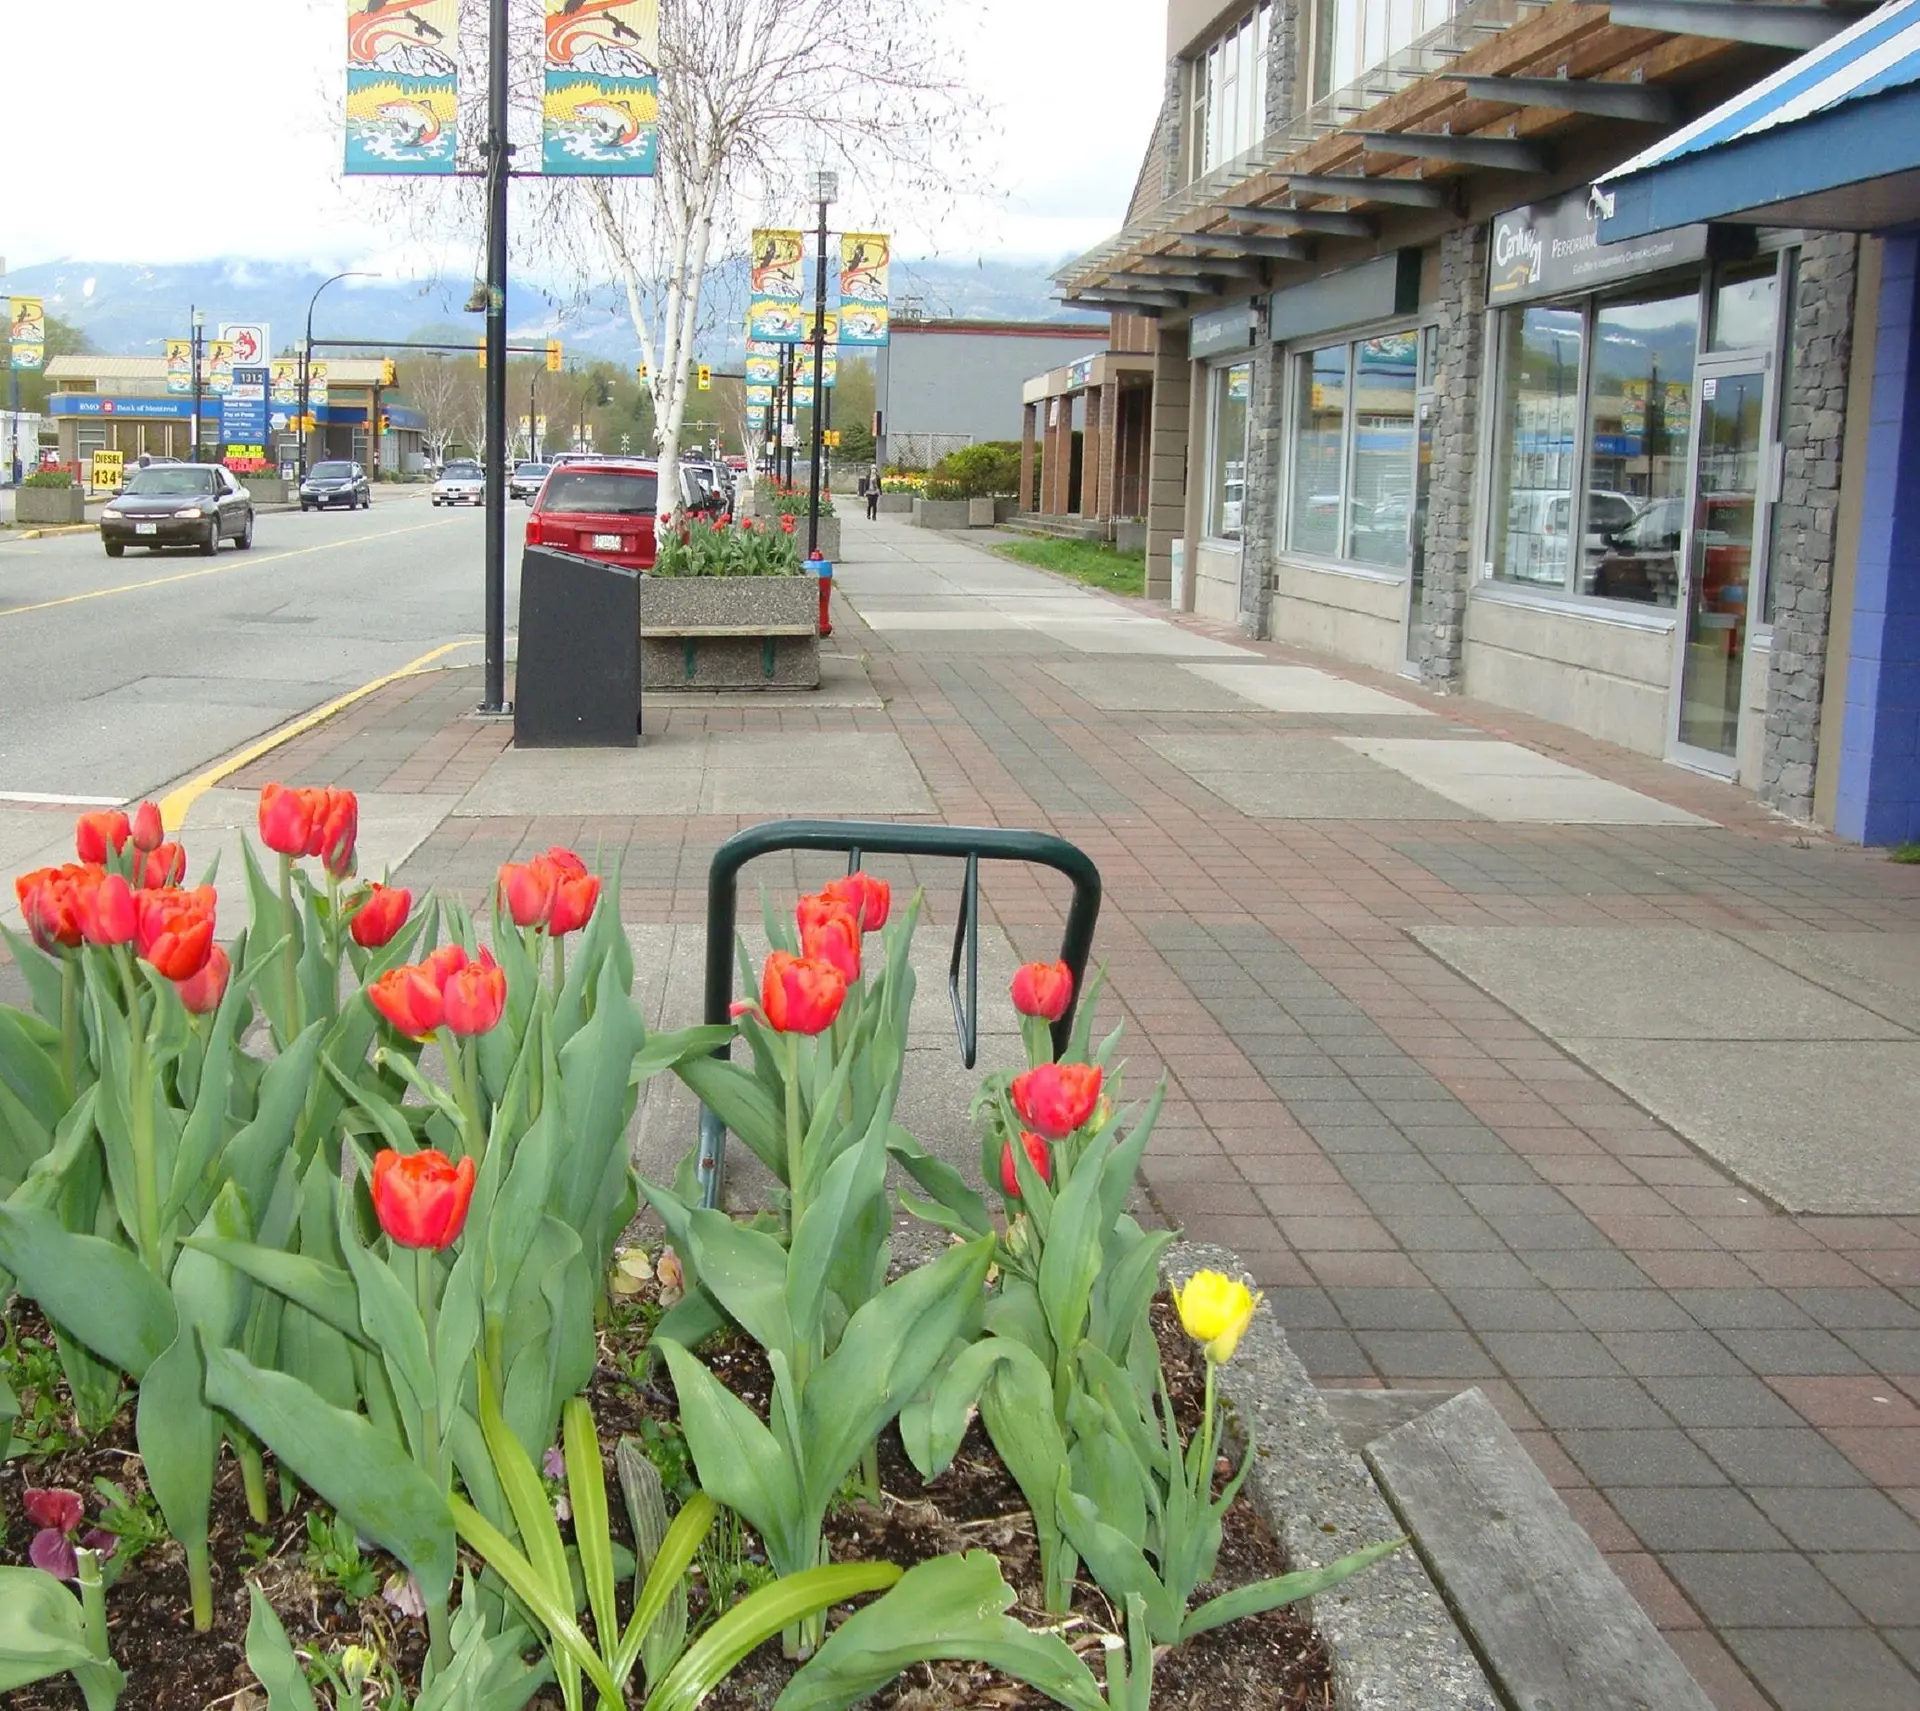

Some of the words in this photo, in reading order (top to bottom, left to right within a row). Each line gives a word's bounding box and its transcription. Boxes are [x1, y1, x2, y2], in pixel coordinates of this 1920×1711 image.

[1496, 224, 1536, 267] Century
[1528, 241, 1542, 284] 21
[80, 403, 100, 411] BMO
[117, 404, 135, 412] Bank
[136, 404, 144, 412] of
[145, 404, 177, 413] Montreal
[95, 454, 121, 464] DIESEL
